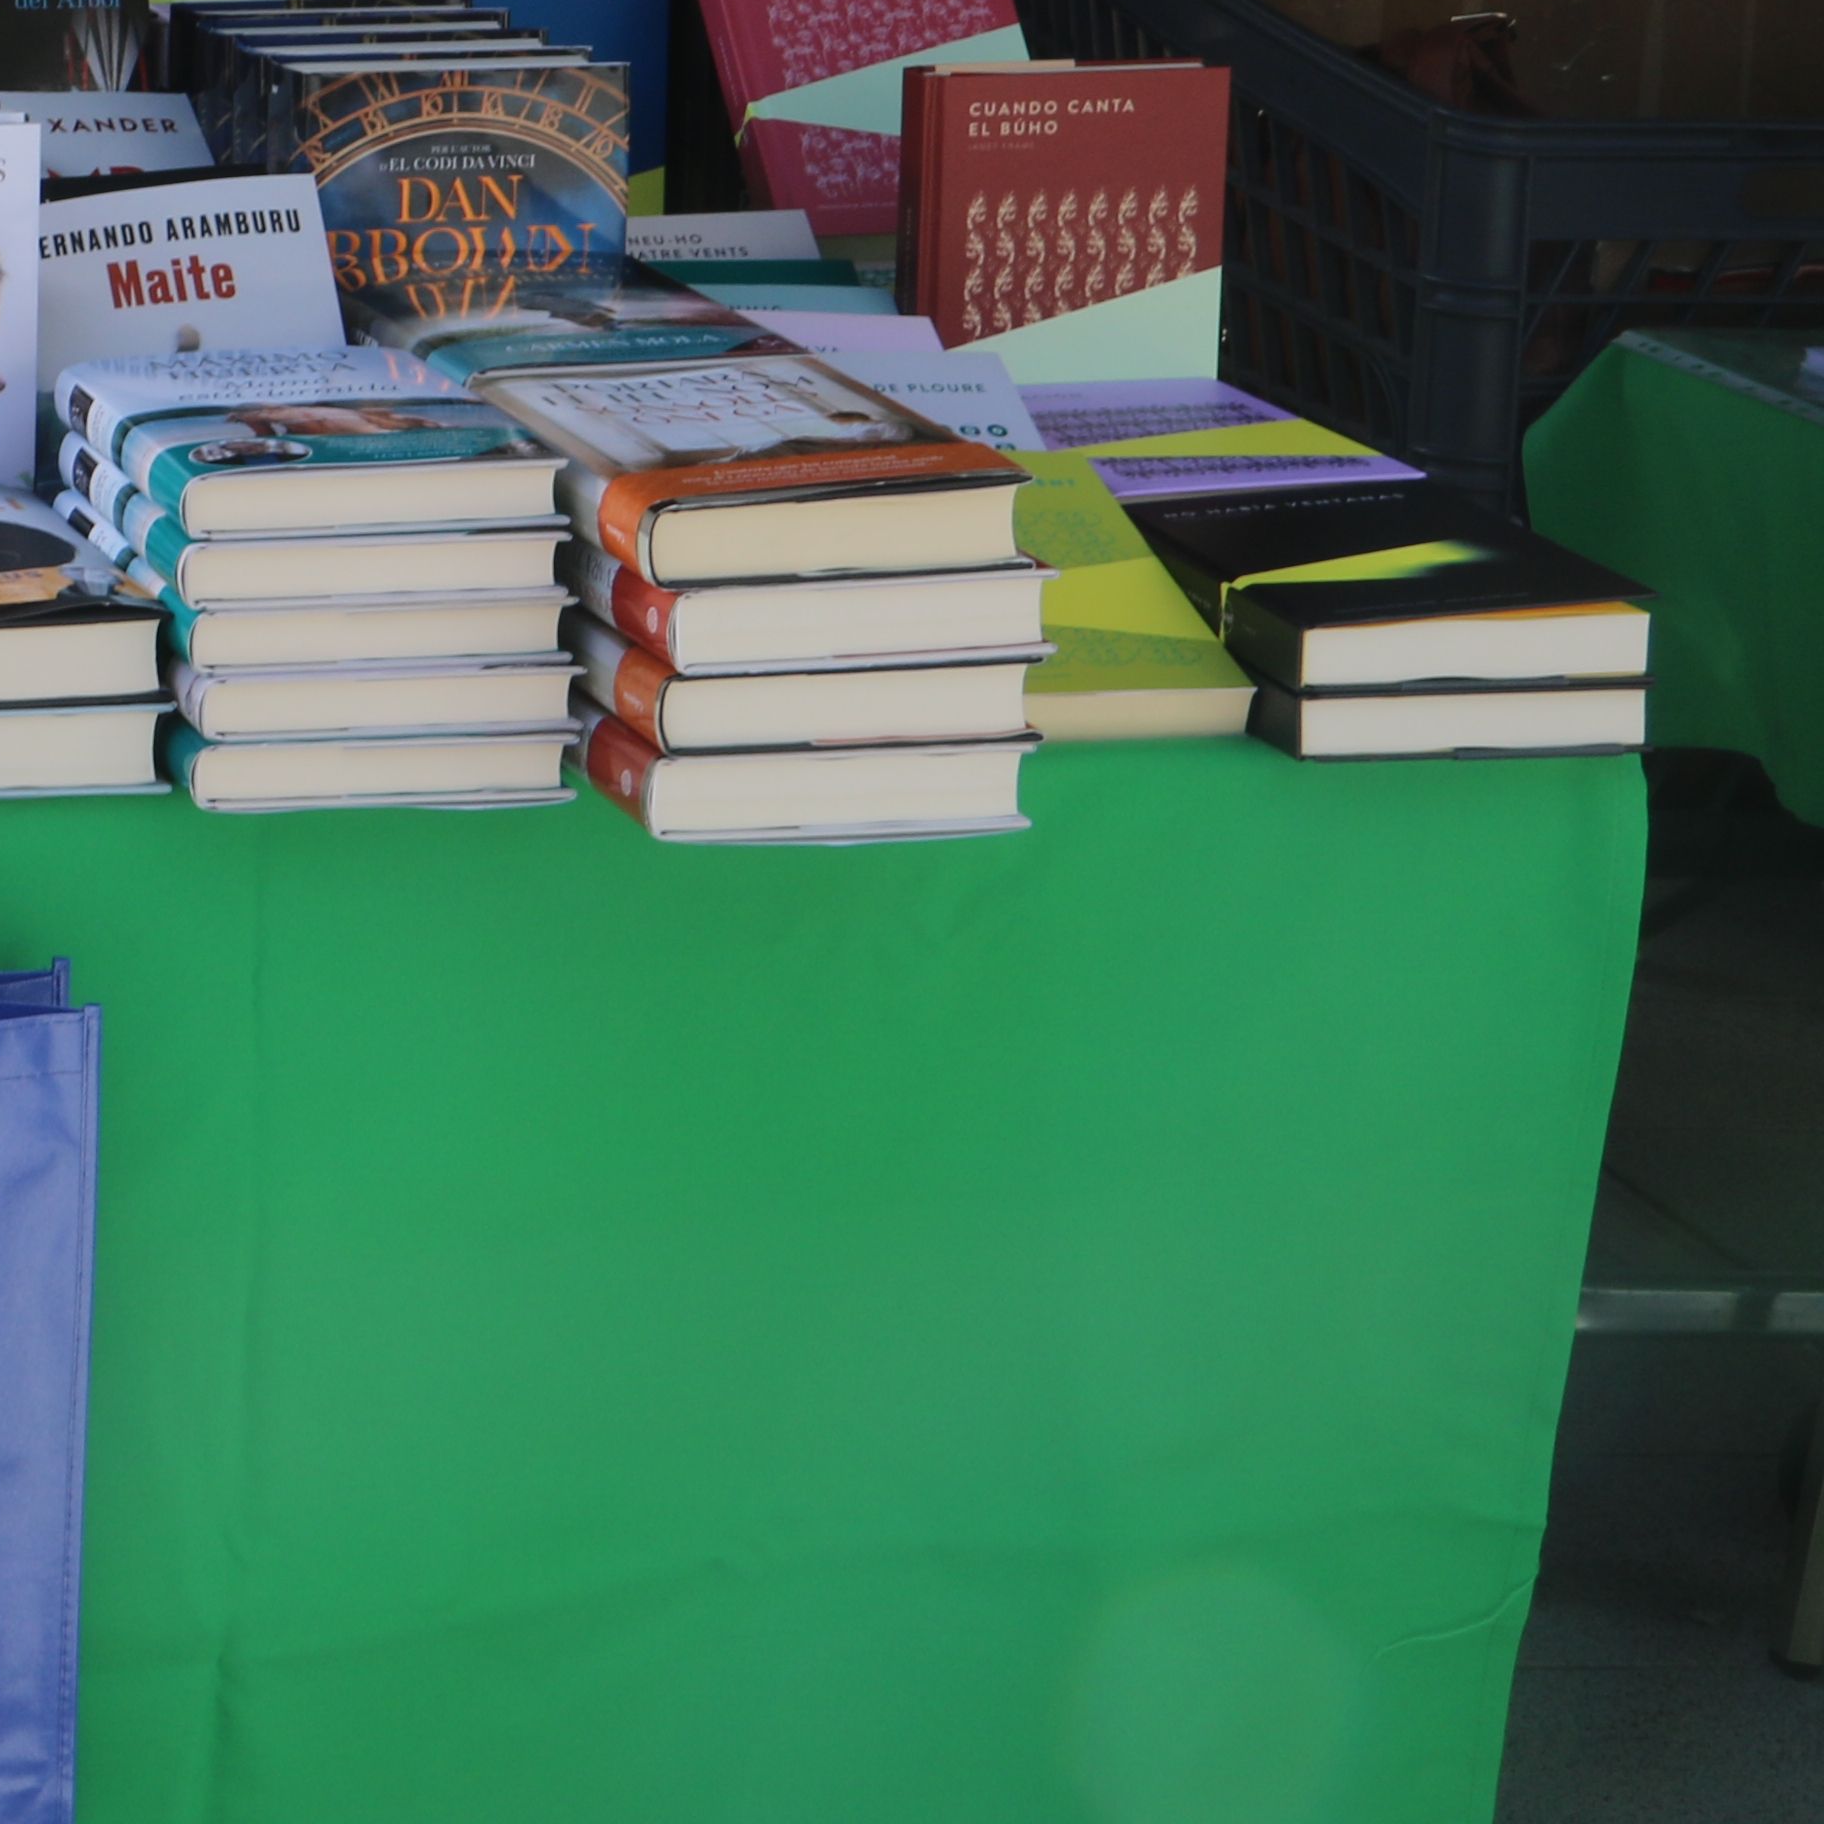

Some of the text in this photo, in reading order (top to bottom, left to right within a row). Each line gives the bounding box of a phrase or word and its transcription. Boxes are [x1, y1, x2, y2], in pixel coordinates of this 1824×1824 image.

[968, 98, 1136, 118] CUANDO CANTA
[48, 118, 178, 133] XANDER
[968, 117, 1060, 137] EL BÚHO
[414, 156, 458, 172] CODI
[462, 155, 485, 170] DA
[487, 153, 536, 169] VINCI
[397, 174, 524, 224] DAN
[39, 209, 302, 259] ERNANDO ARAMBURU
[688, 246, 750, 259] VENTS
[106, 255, 237, 309] Maite
[873, 382, 987, 393] DE PLOURE
